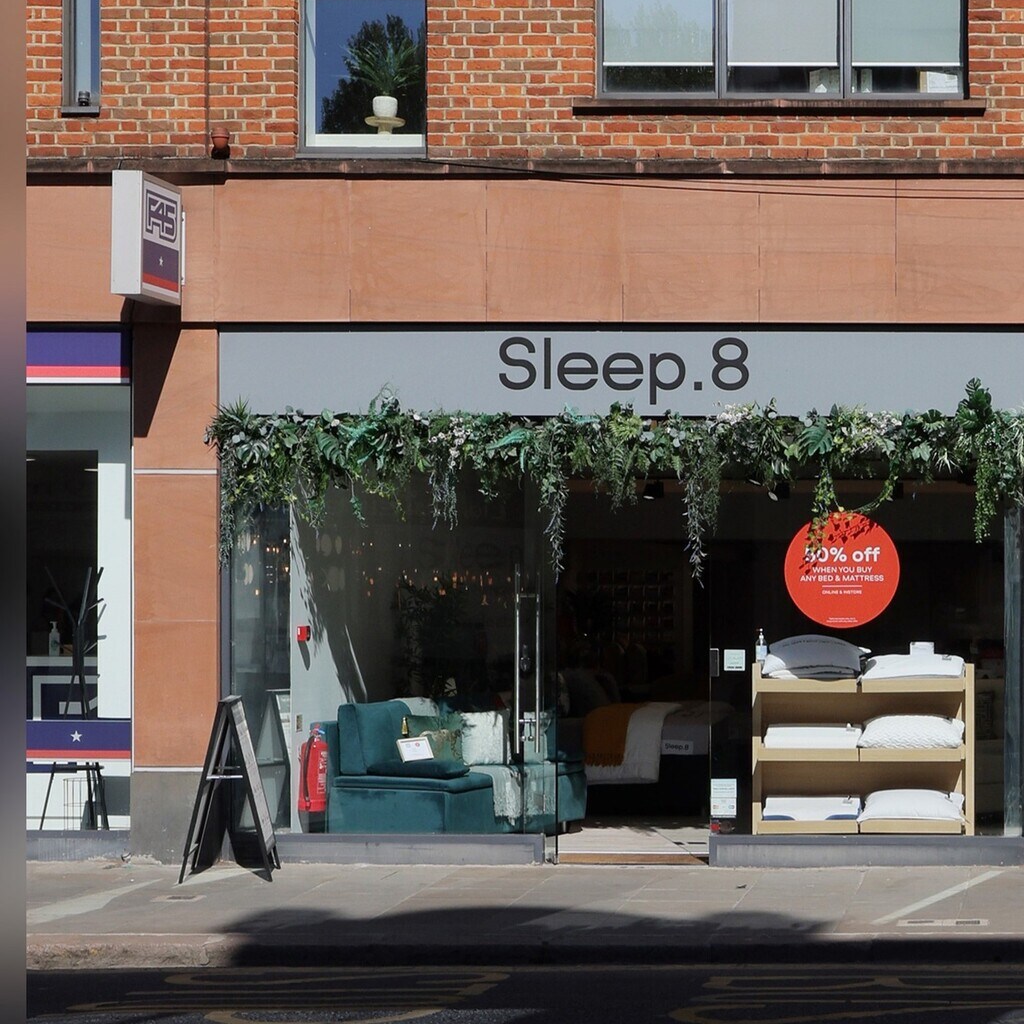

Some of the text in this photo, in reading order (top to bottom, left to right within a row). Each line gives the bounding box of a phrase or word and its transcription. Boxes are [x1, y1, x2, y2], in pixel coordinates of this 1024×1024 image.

[145, 188, 178, 244] F45
[498, 336, 750, 406] Sleep.8
[851, 546, 881, 563] off
[799, 574, 885, 582] ANY BED & MATTRESS
[811, 566, 873, 574] WHEN YOU BUY
